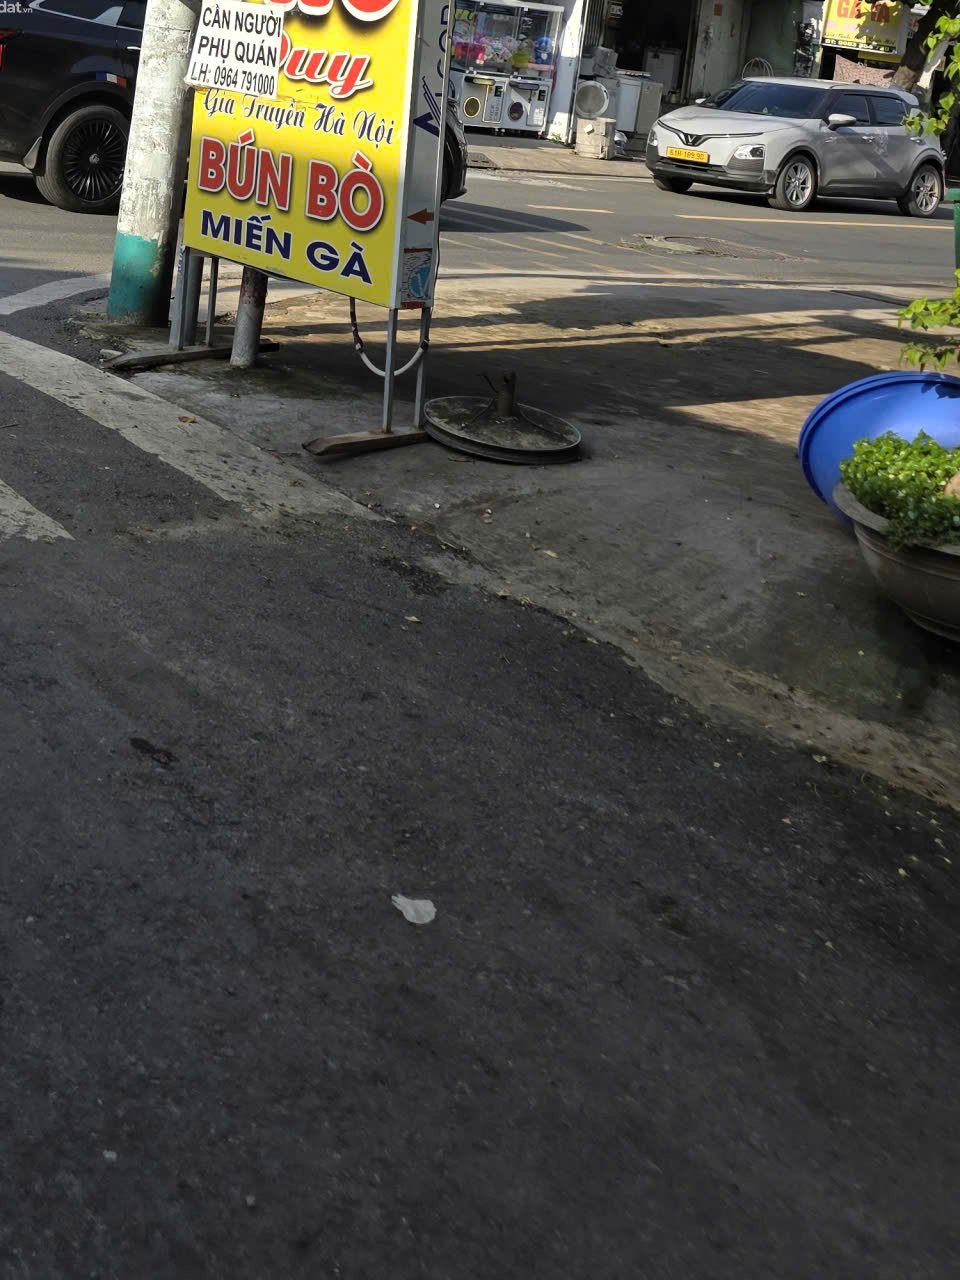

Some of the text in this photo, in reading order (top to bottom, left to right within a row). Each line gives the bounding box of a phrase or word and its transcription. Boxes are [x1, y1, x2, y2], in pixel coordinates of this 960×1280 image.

[202, 4, 282, 38] CẦN NGƯỜI
[197, 35, 278, 68] PHỤ QUÁN
[190, 61, 275, 96] LH: 0964 791000
[203, 86, 235, 118] Gia
[313, 102, 345, 136] Hà
[352, 109, 395, 149] Nội
[198, 128, 384, 231] BÚN BÒ
[201, 209, 291, 260] MIẾN
[306, 240, 373, 285] GÀ
